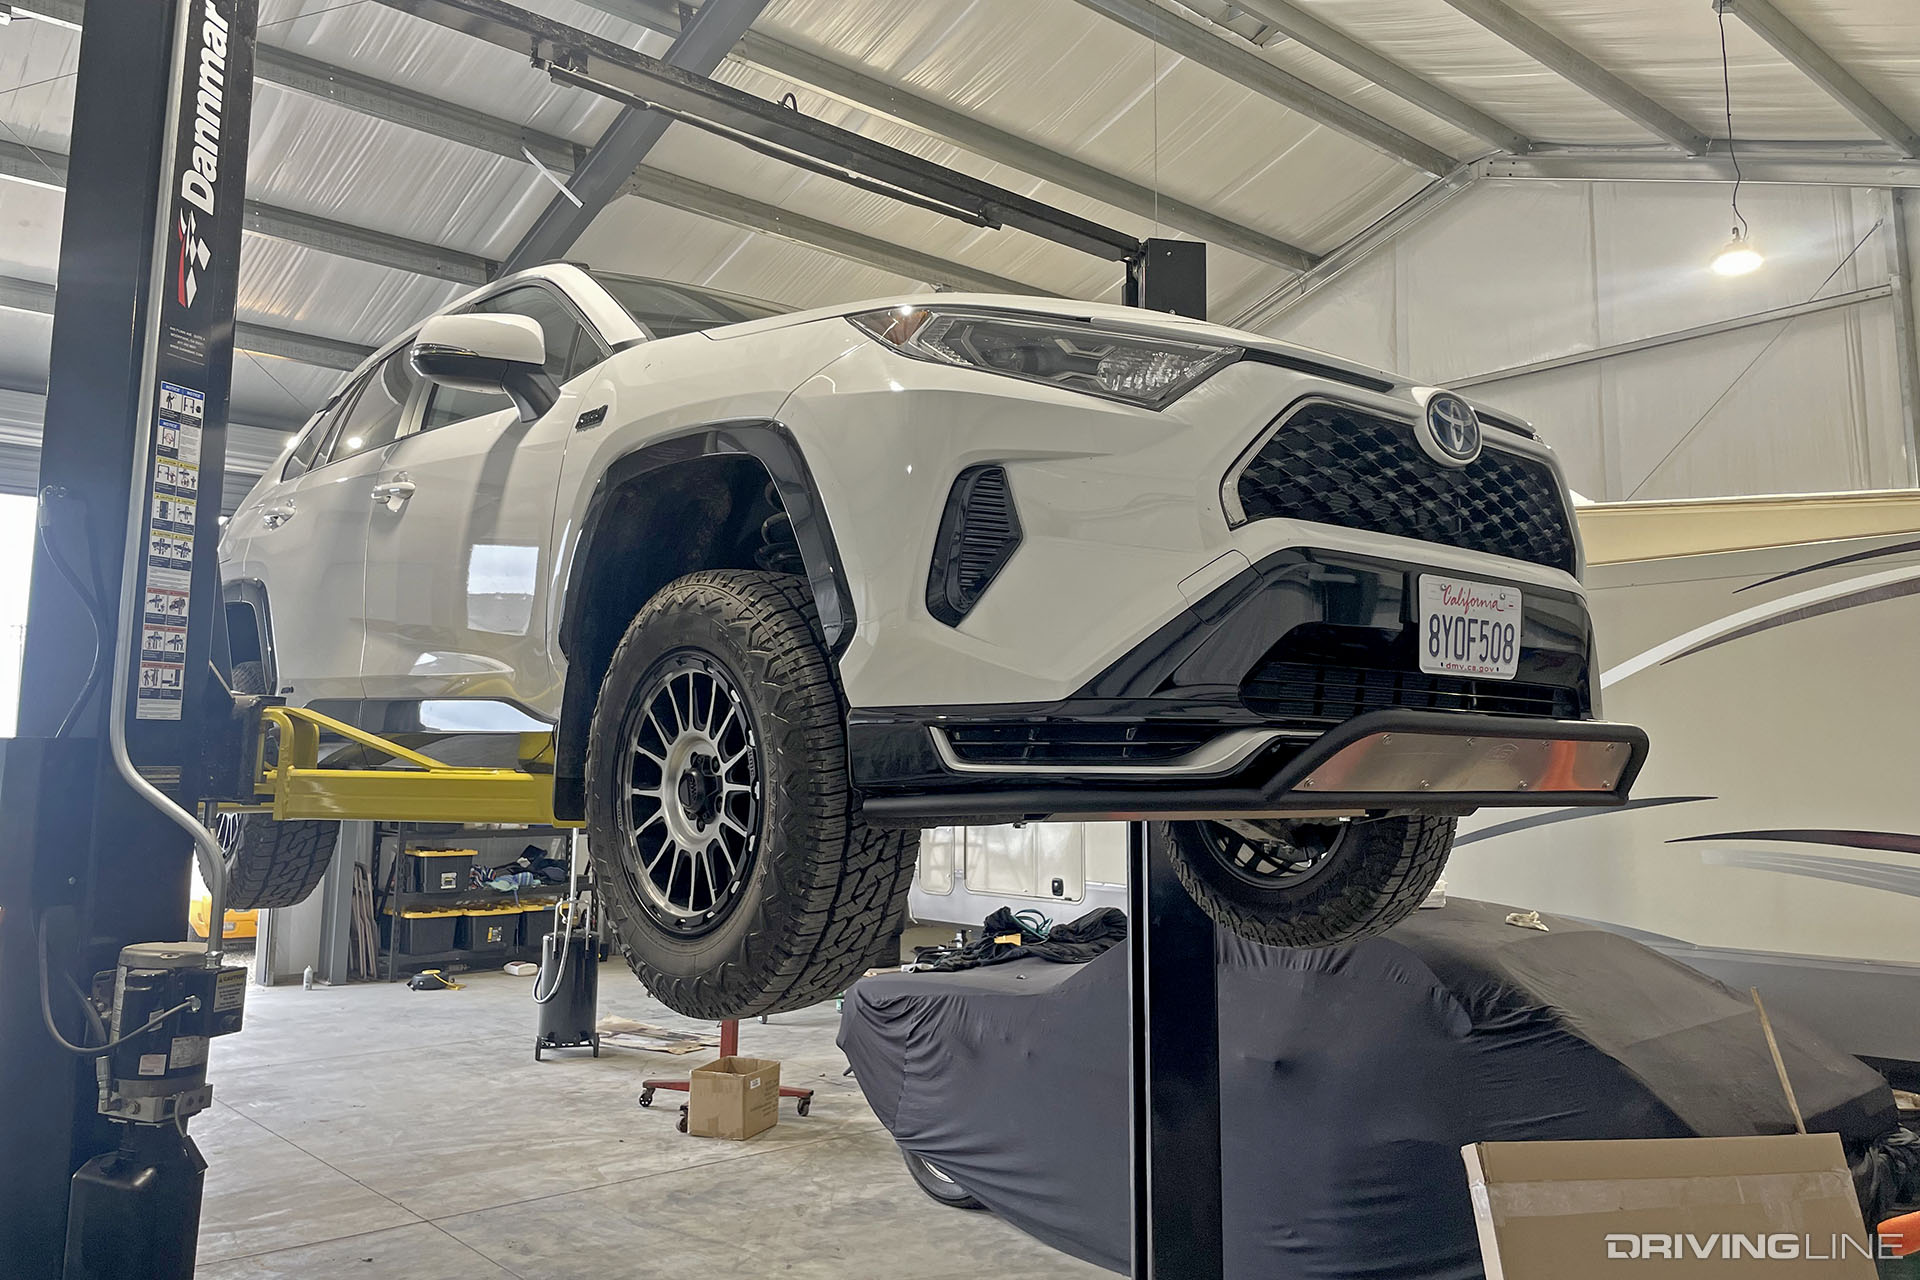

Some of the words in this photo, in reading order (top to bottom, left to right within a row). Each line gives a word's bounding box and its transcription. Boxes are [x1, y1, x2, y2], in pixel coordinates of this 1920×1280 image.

[181, 0, 229, 216] Dannmar
[1443, 584, 1504, 615] California
[1428, 613, 1515, 664] 8YOF508
[1445, 661, 1495, 673] dmv.ca.gov
